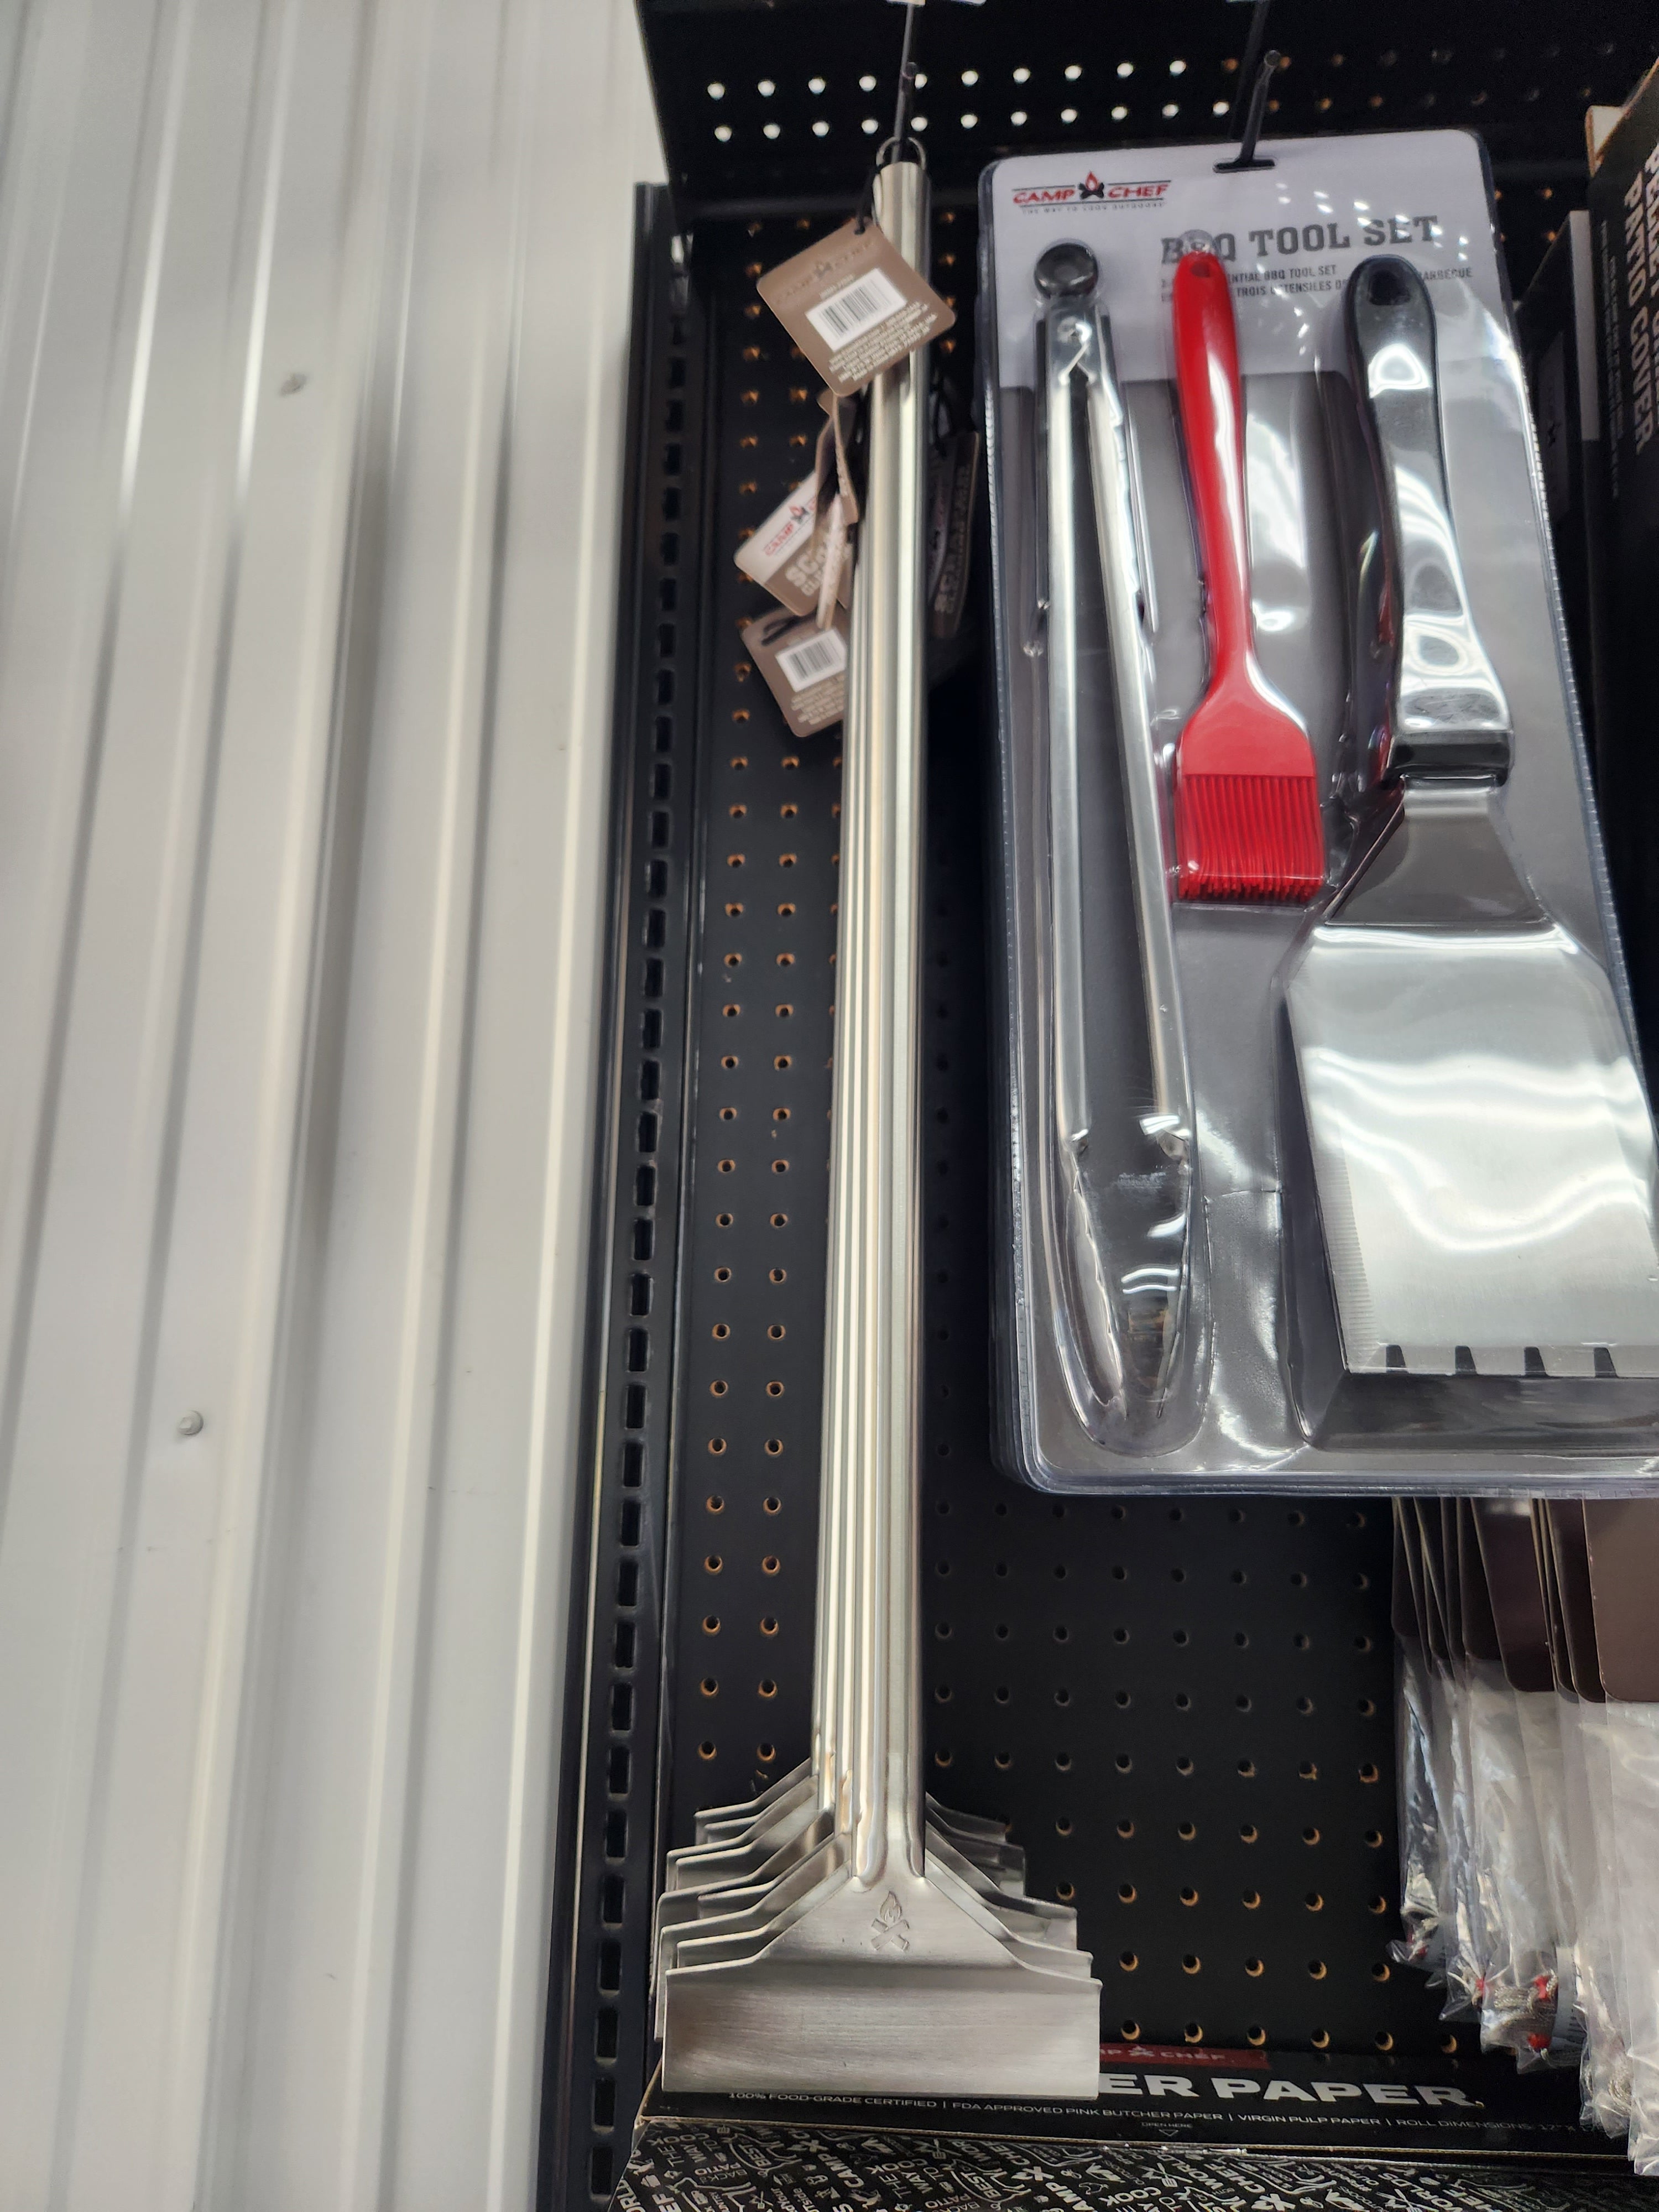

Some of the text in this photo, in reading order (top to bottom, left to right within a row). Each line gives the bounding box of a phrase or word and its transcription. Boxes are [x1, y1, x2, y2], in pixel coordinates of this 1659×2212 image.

[1013, 184, 1169, 205] CAMP CHEF
[1161, 215, 1438, 264] BQ TOOL SET
[1289, 267, 1316, 279] TOOL
[1318, 264, 1336, 276] SET
[1237, 286, 1266, 298] TROIS
[1624, 171, 1653, 456] PATIO COVER
[1211, 2078, 1478, 2106] PAPER
[769, 2093, 862, 2104] FOOD-GRADE
[864, 2098, 937, 2107] CERTIFIED
[983, 2104, 1063, 2114] APPROVED
[1065, 2107, 1100, 2116] PINK
[1102, 2109, 1171, 2119] BUTCHER
[1173, 2112, 1224, 2120] PAPER
[1237, 2114, 1286, 2122] VIRGIN
[1288, 2116, 1328, 2124] PULP
[1330, 2117, 1381, 2125] PAPER
[1395, 2119, 1437, 2127] ROLL
[646, 2132, 710, 2146] COOK
[658, 2144, 685, 2168] THE
[681, 2144, 708, 2163] WAY
[737, 2143, 772, 2167] BEST
[695, 2162, 743, 2176] PATIO
[817, 2153, 864, 2188] CAMP
[865, 2158, 944, 2199] THE WAY TO COOK
[959, 2172, 1002, 2199] BEST
[1045, 2182, 1096, 2212] AMP
[1098, 2187, 1162, 2206] COOK
[651, 2193, 682, 2212] EF
[924, 2193, 972, 2209] PATIO
